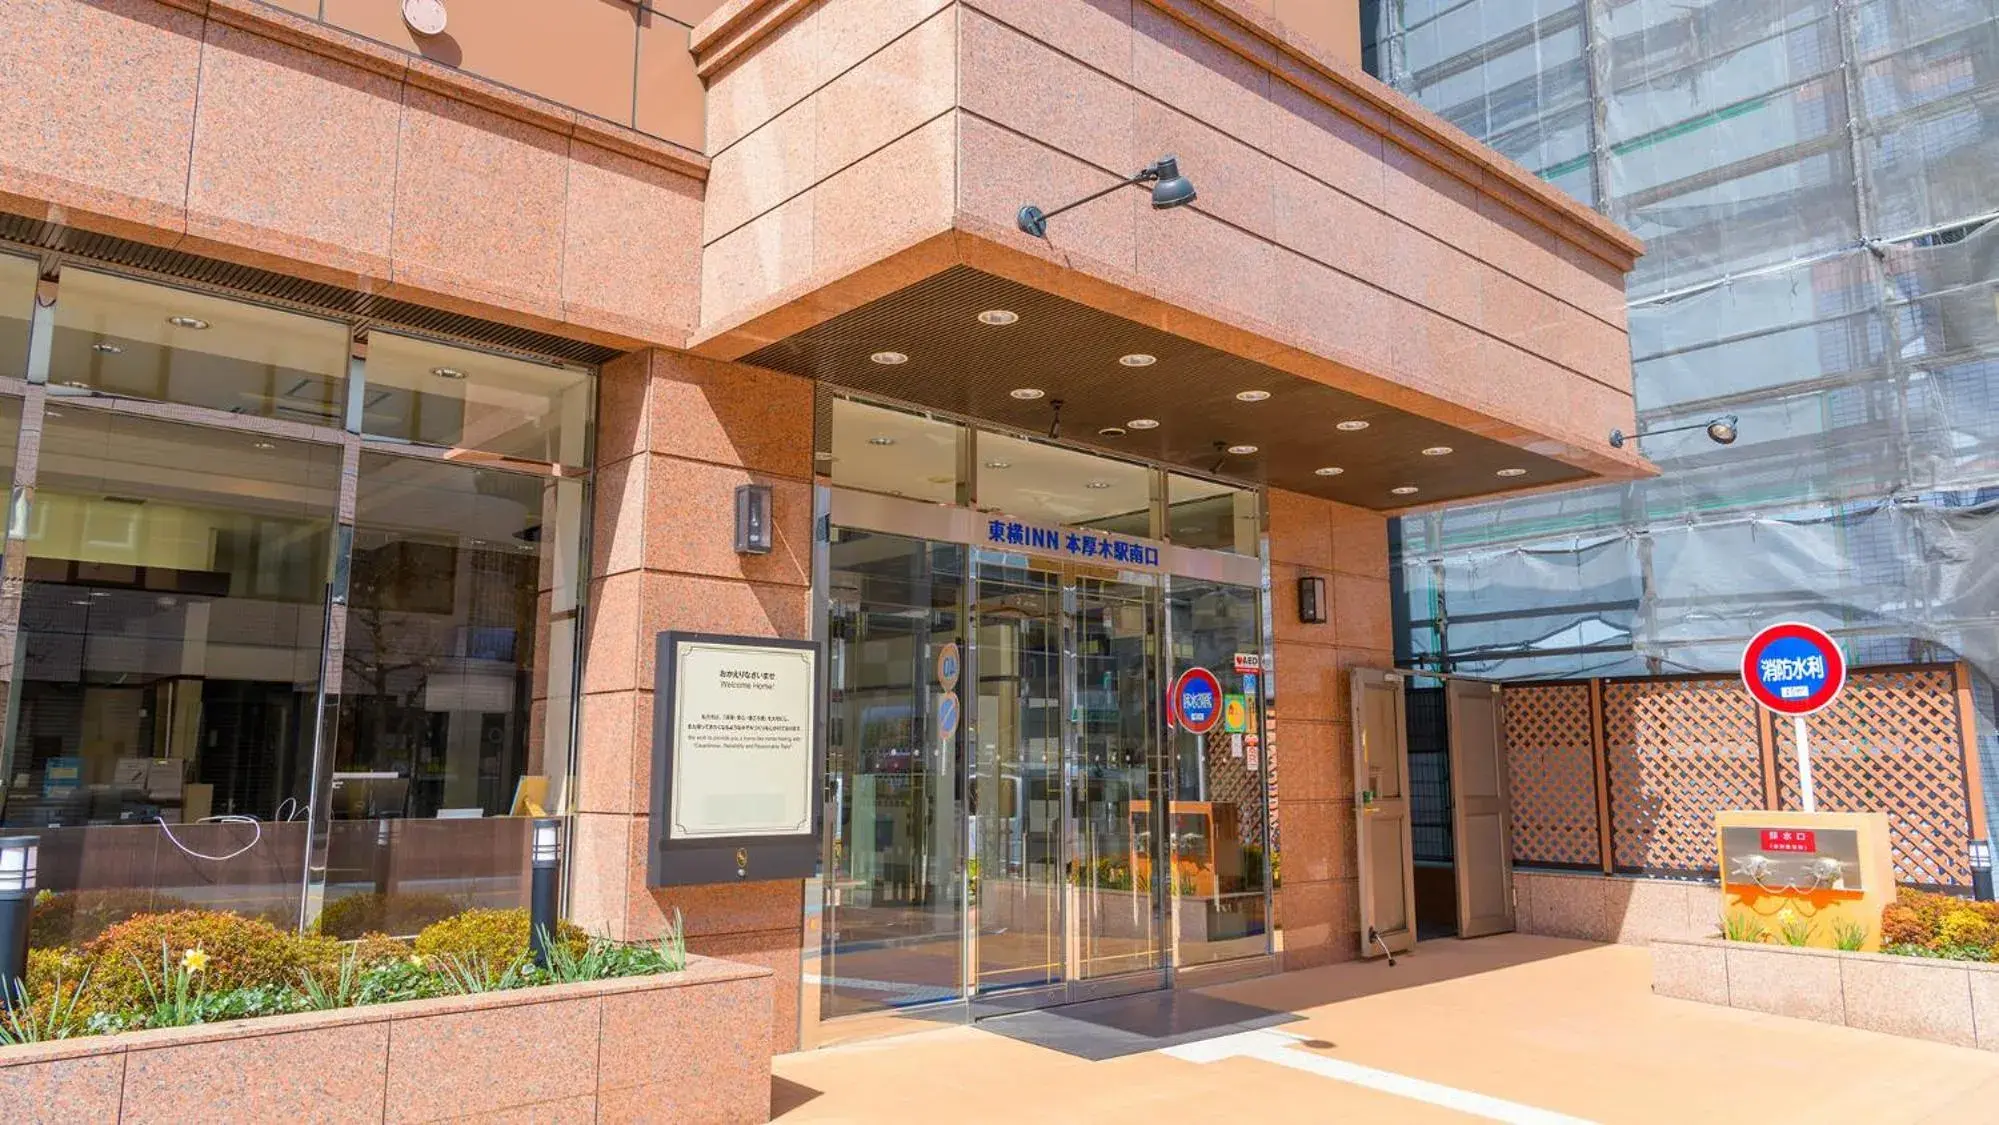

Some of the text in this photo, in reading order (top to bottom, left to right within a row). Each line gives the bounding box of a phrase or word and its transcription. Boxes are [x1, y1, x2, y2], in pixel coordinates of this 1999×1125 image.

[988, 519, 1159, 566] 東横INN 本厚木駅南口
[1243, 656, 1258, 665] AED
[1761, 655, 1825, 682] 消防水利
[720, 670, 775, 680] おかえりなさいませ
[721, 681, 751, 689] Welcome
